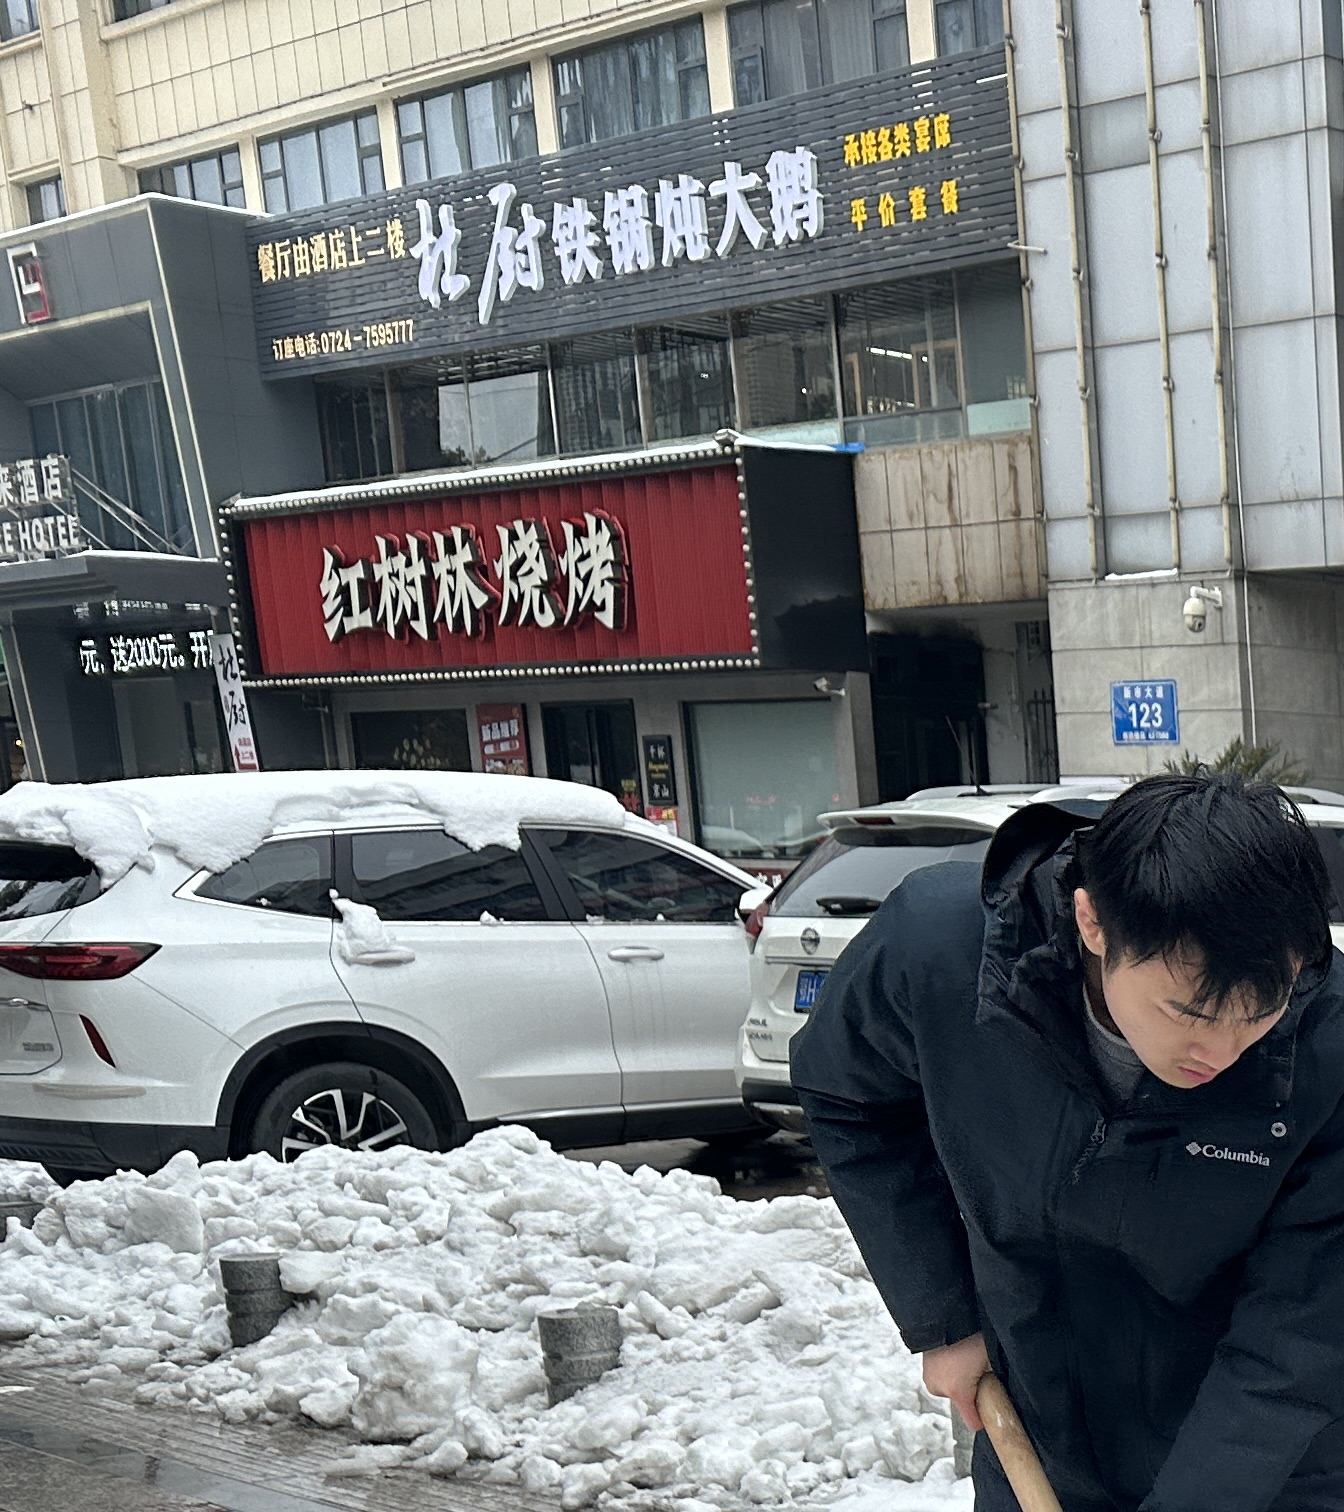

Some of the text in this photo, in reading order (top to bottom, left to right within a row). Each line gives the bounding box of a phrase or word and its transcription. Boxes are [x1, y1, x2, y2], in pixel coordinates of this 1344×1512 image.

[843, 112, 951, 168] 承接各类宴席
[552, 146, 824, 286] 铁锅炖大鹅
[850, 178, 959, 232] 平价套餐
[257, 218, 406, 283] 餐厅由酒店上二楼
[320, 510, 622, 643] 红树林烧烤
[1128, 702, 1163, 728] 123
[1202, 1144, 1270, 1167] Columbia
